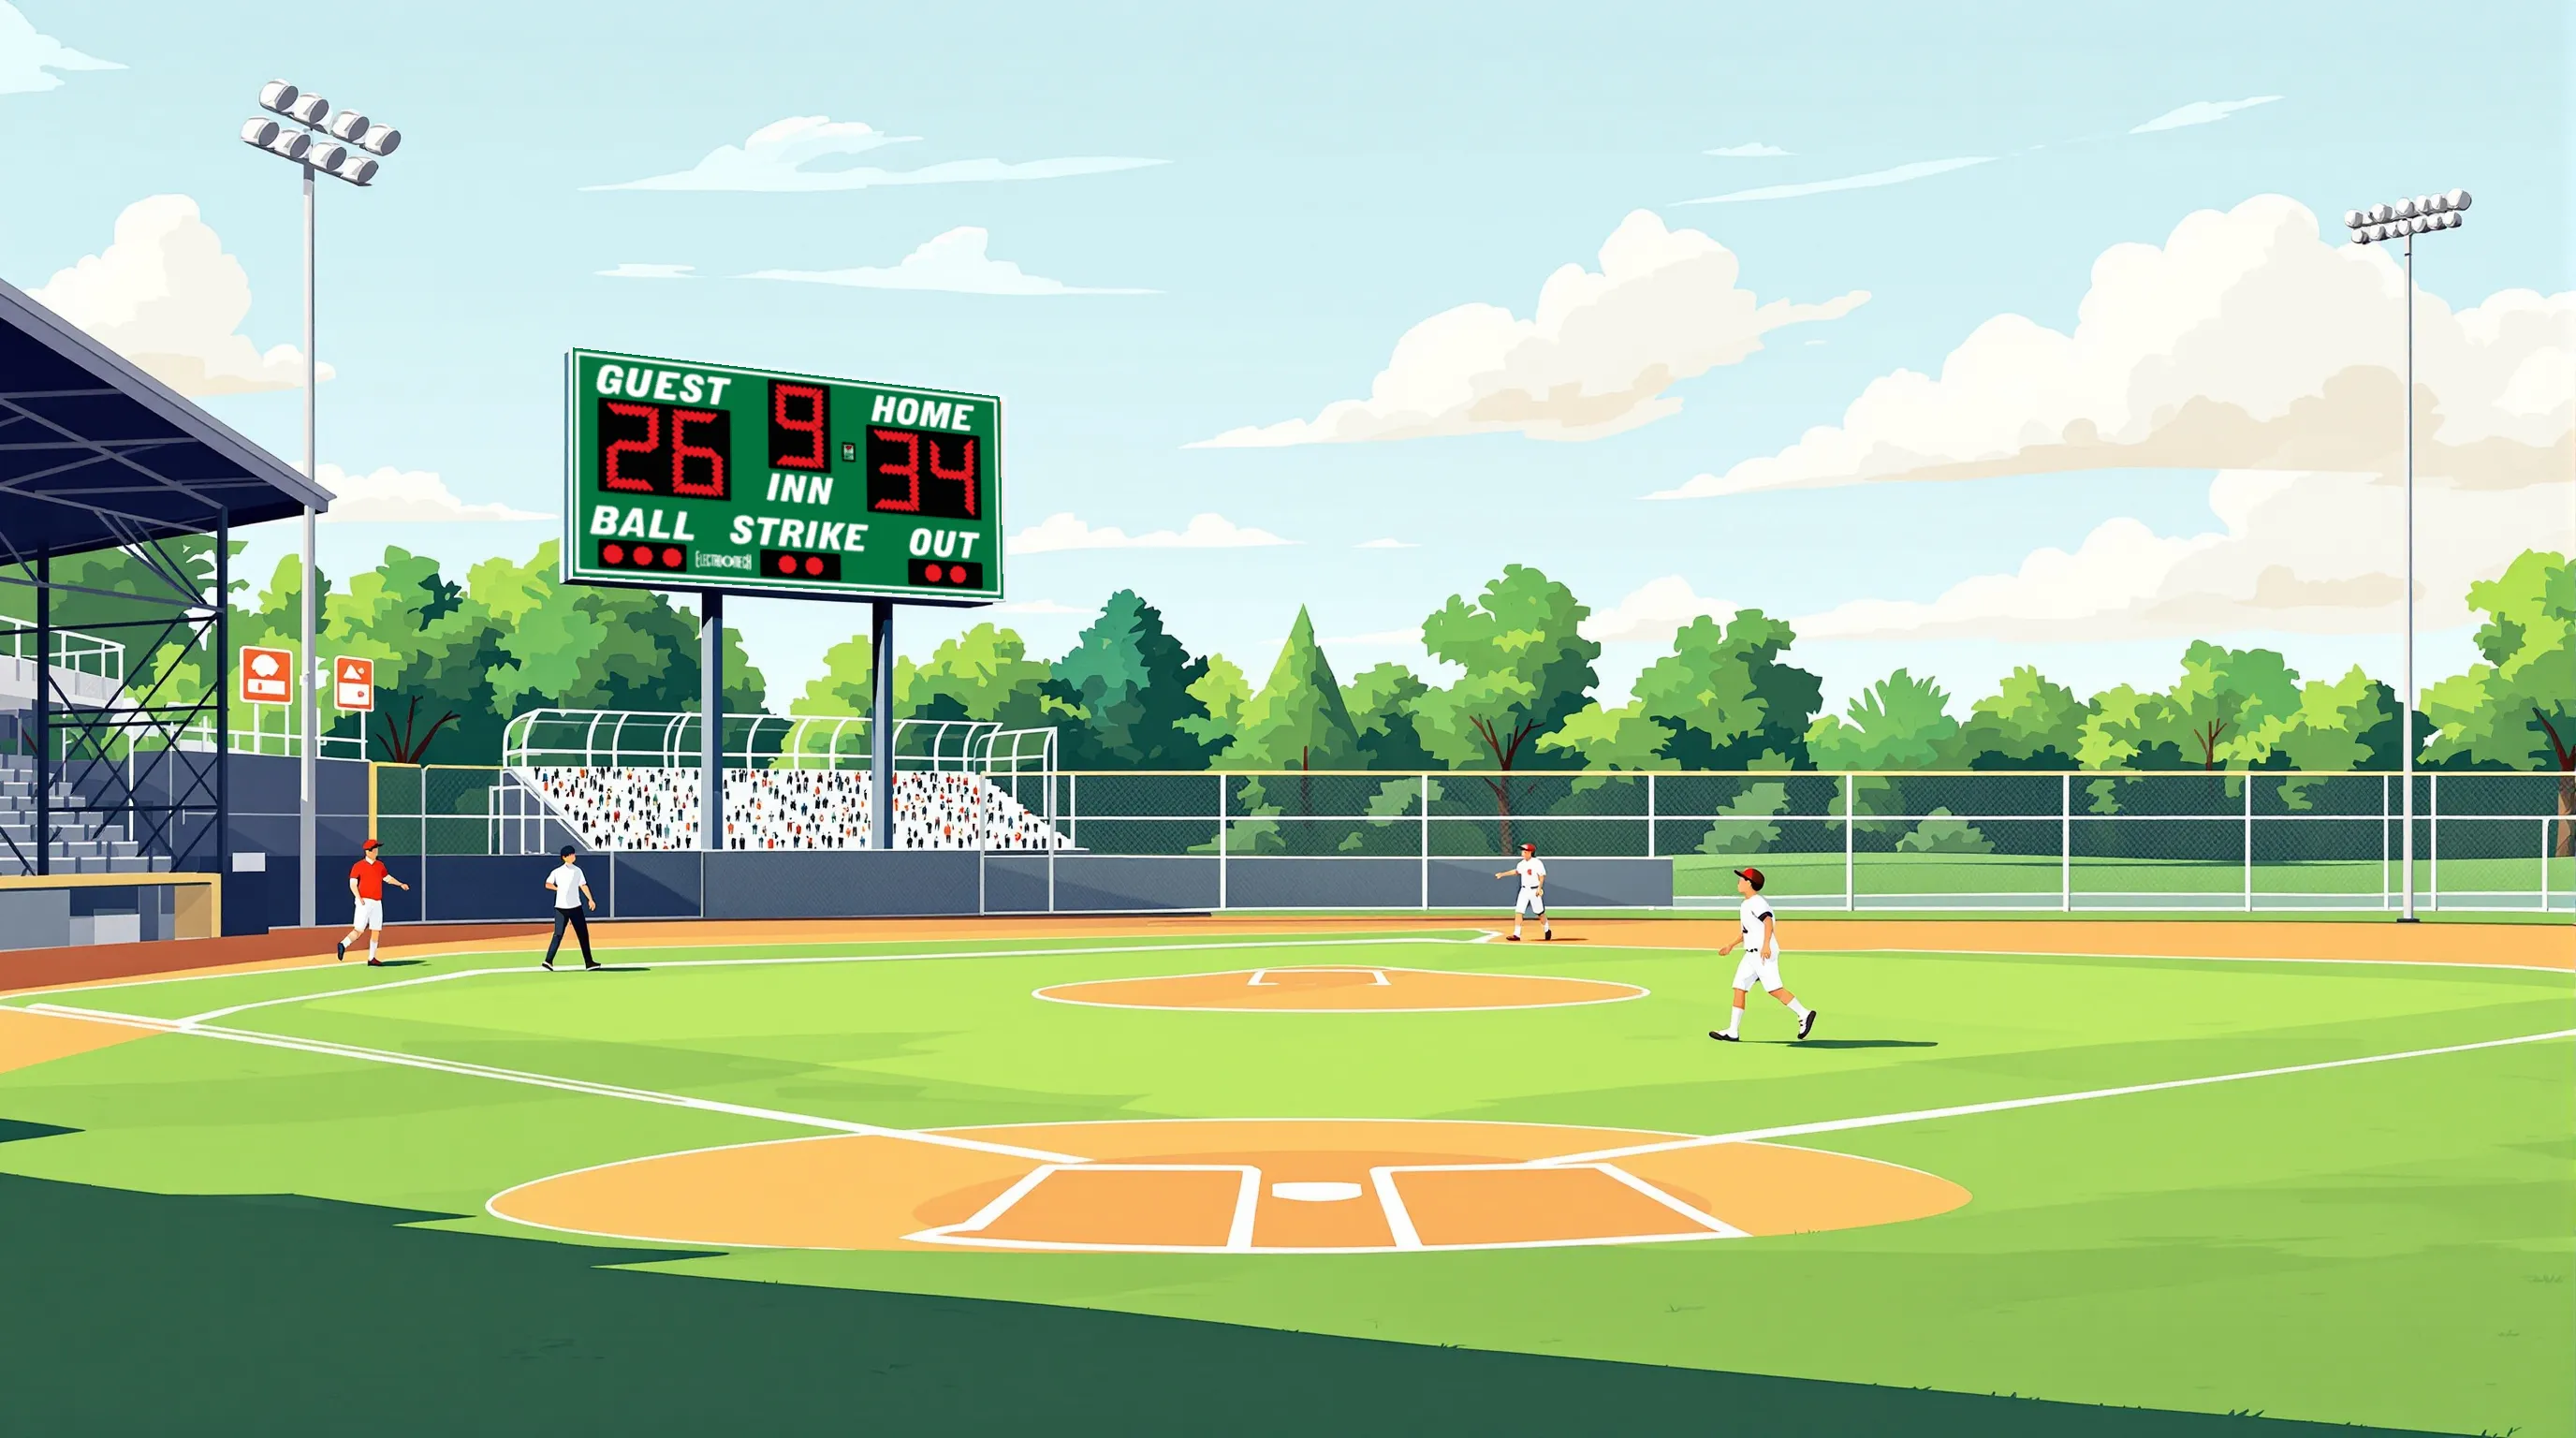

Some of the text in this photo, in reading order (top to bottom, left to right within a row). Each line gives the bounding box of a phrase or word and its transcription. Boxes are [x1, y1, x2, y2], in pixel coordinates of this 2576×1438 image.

[596, 364, 732, 405] GUEST
[776, 385, 824, 468] 9
[871, 394, 974, 432] HOME
[607, 403, 723, 495] 26
[766, 473, 833, 506] INN
[874, 430, 974, 515] 34
[590, 505, 695, 541] BALL
[729, 515, 869, 552] STRIKE
[909, 527, 980, 559] OUT
